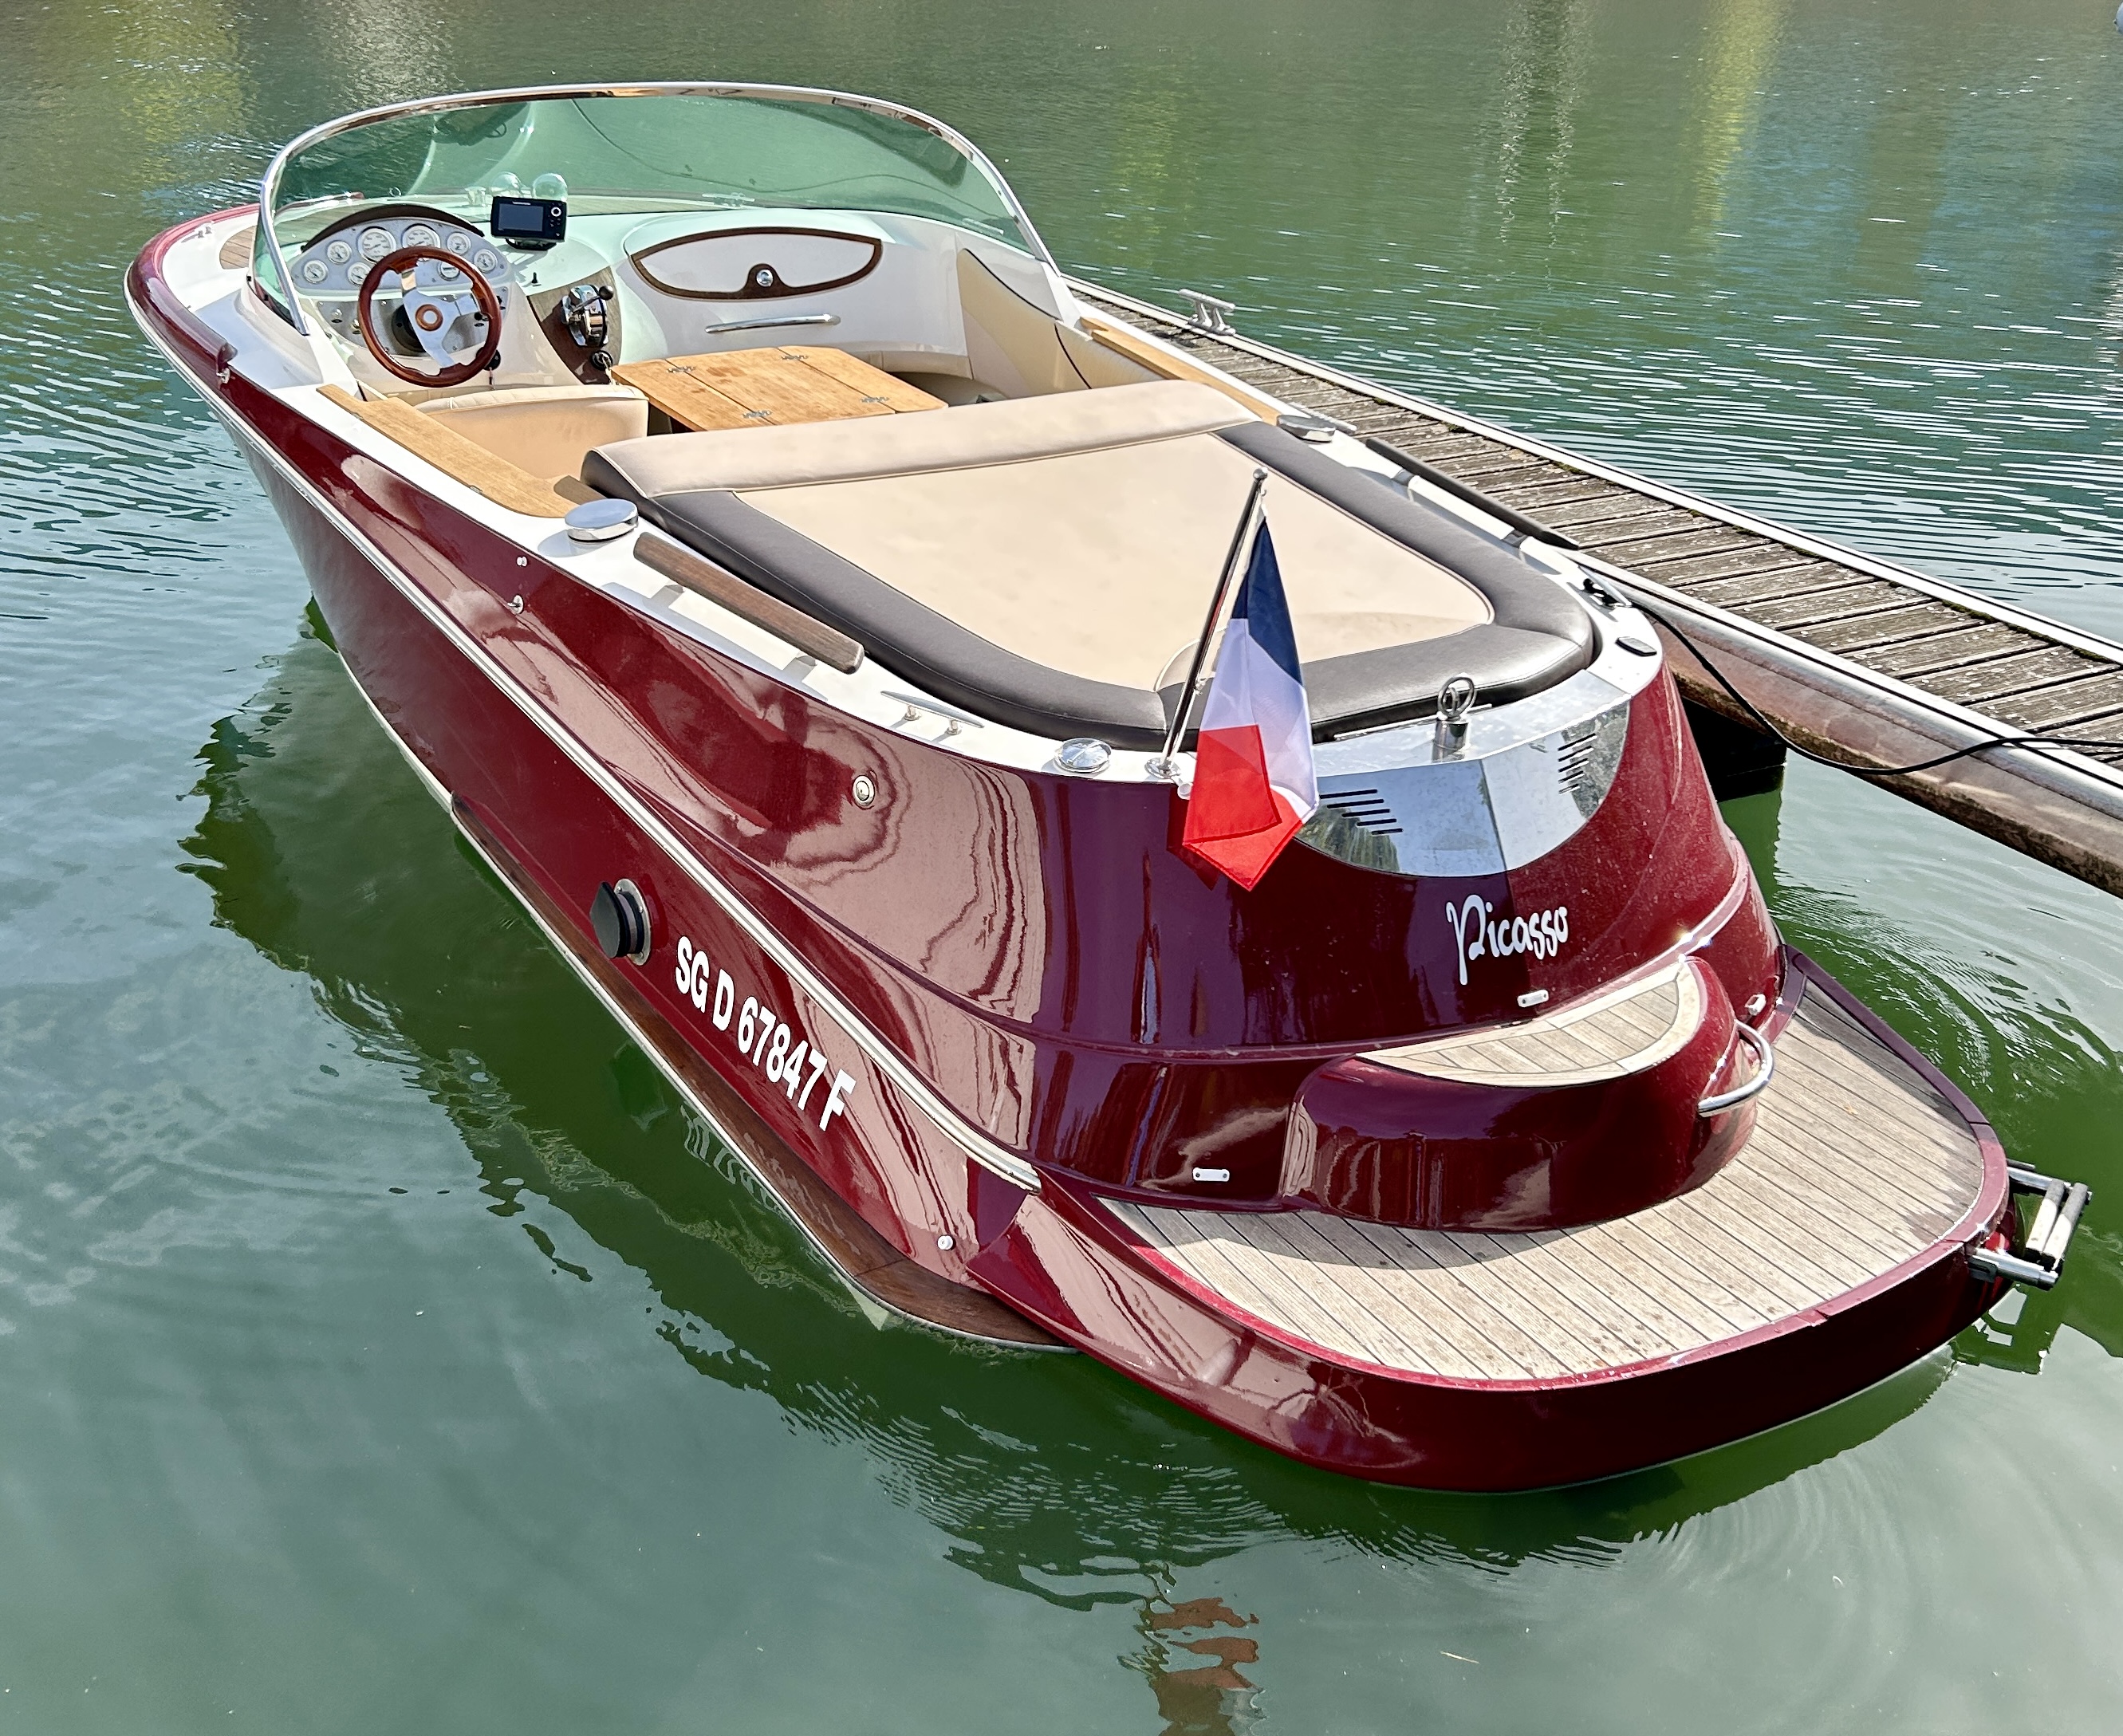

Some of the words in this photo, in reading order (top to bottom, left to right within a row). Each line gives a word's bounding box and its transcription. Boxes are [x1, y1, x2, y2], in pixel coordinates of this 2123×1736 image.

[1446, 894, 1569, 986] Picasso
[676, 936, 710, 1013] SG
[712, 969, 735, 1030] D
[738, 996, 827, 1110] 67847
[819, 1069, 857, 1131] F
